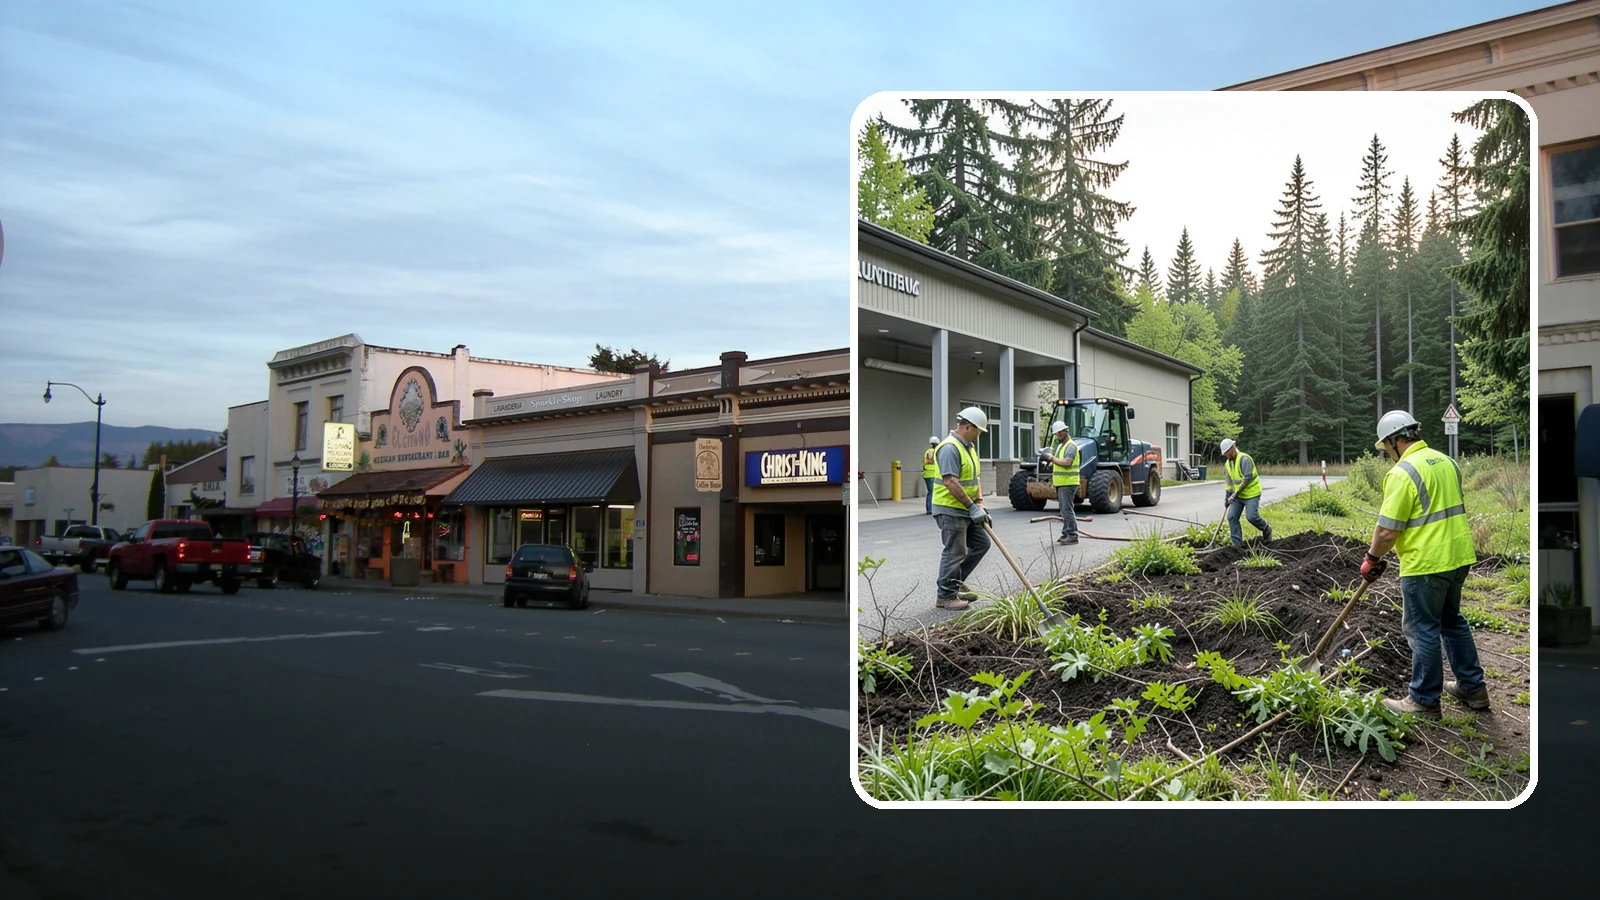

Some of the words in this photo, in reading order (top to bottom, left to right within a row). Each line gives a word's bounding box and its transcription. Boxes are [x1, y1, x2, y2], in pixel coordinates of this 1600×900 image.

[595, 389, 623, 400] LAUNDRY
[493, 402, 522, 413] LAVANDERIA
[530, 399, 560, 409] Sparkle
[562, 395, 582, 405] Shop
[373, 455, 396, 464] MEXICAN
[397, 452, 434, 462] RESTAURANT
[437, 450, 450, 459] BAR
[799, 450, 827, 476] KING
